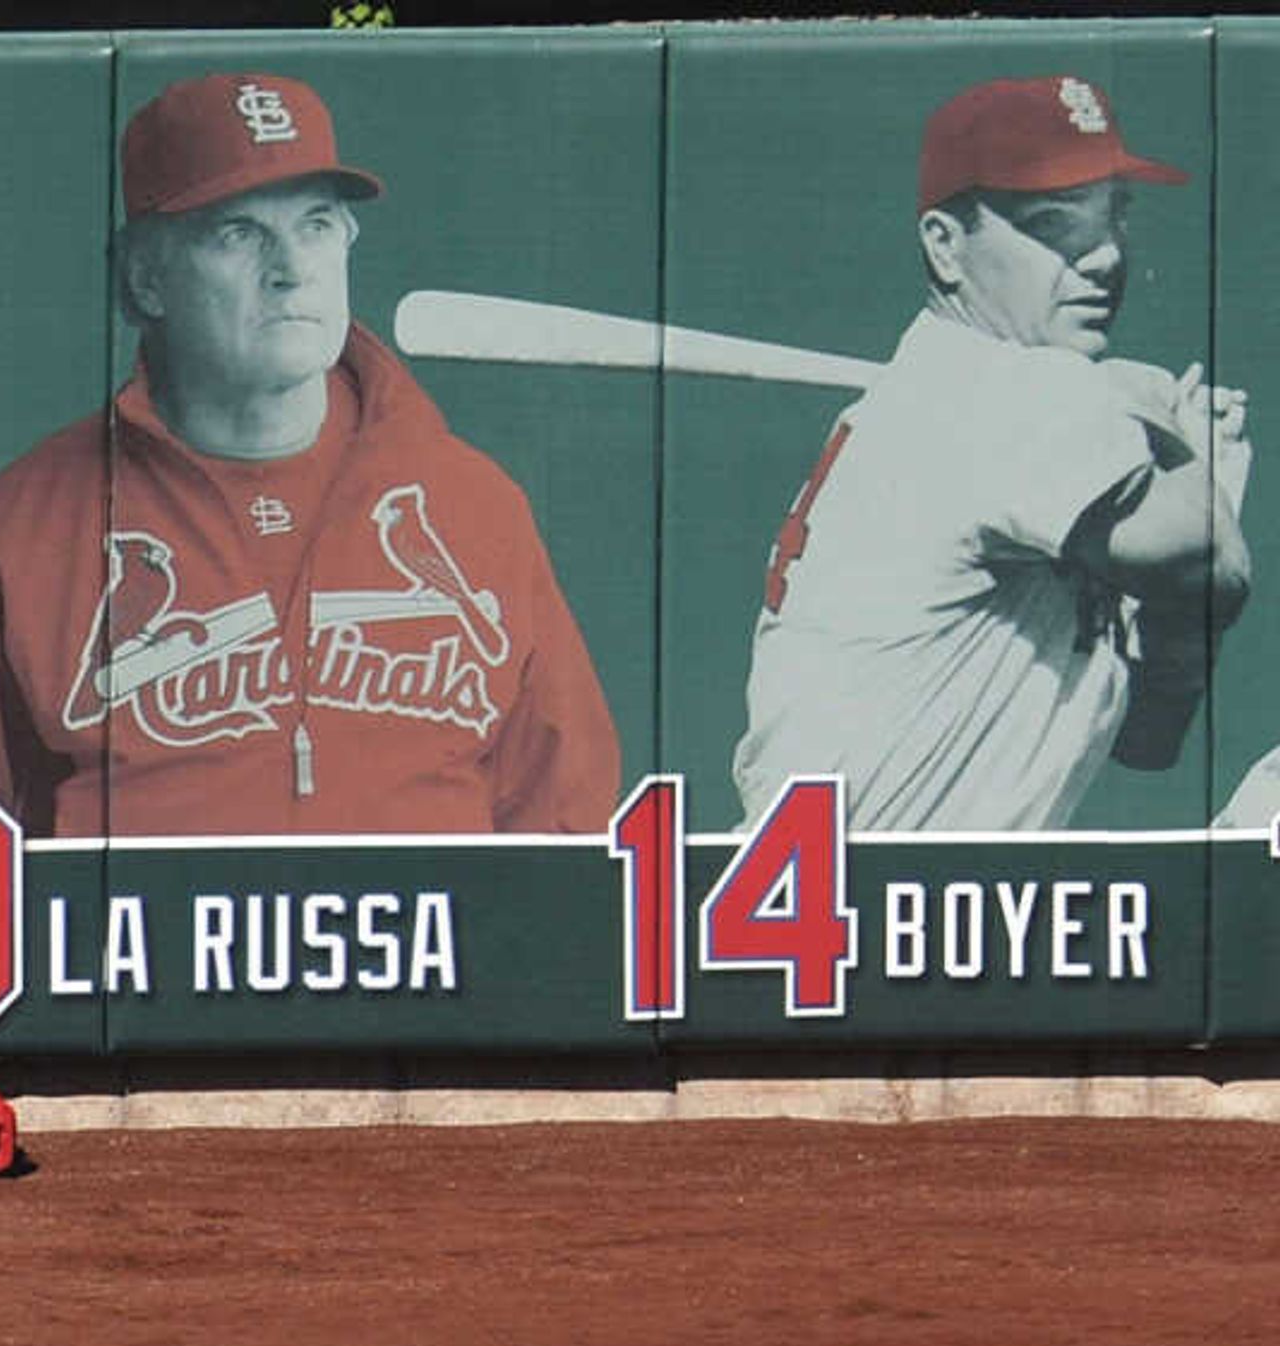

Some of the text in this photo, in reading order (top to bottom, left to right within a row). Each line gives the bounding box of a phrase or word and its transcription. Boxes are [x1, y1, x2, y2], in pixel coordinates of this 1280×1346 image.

[130, 609, 500, 748] Cardinals
[48, 895, 150, 996] LA
[192, 891, 457, 992] RUSSA
[608, 774, 1150, 1021] 14 BOYER
